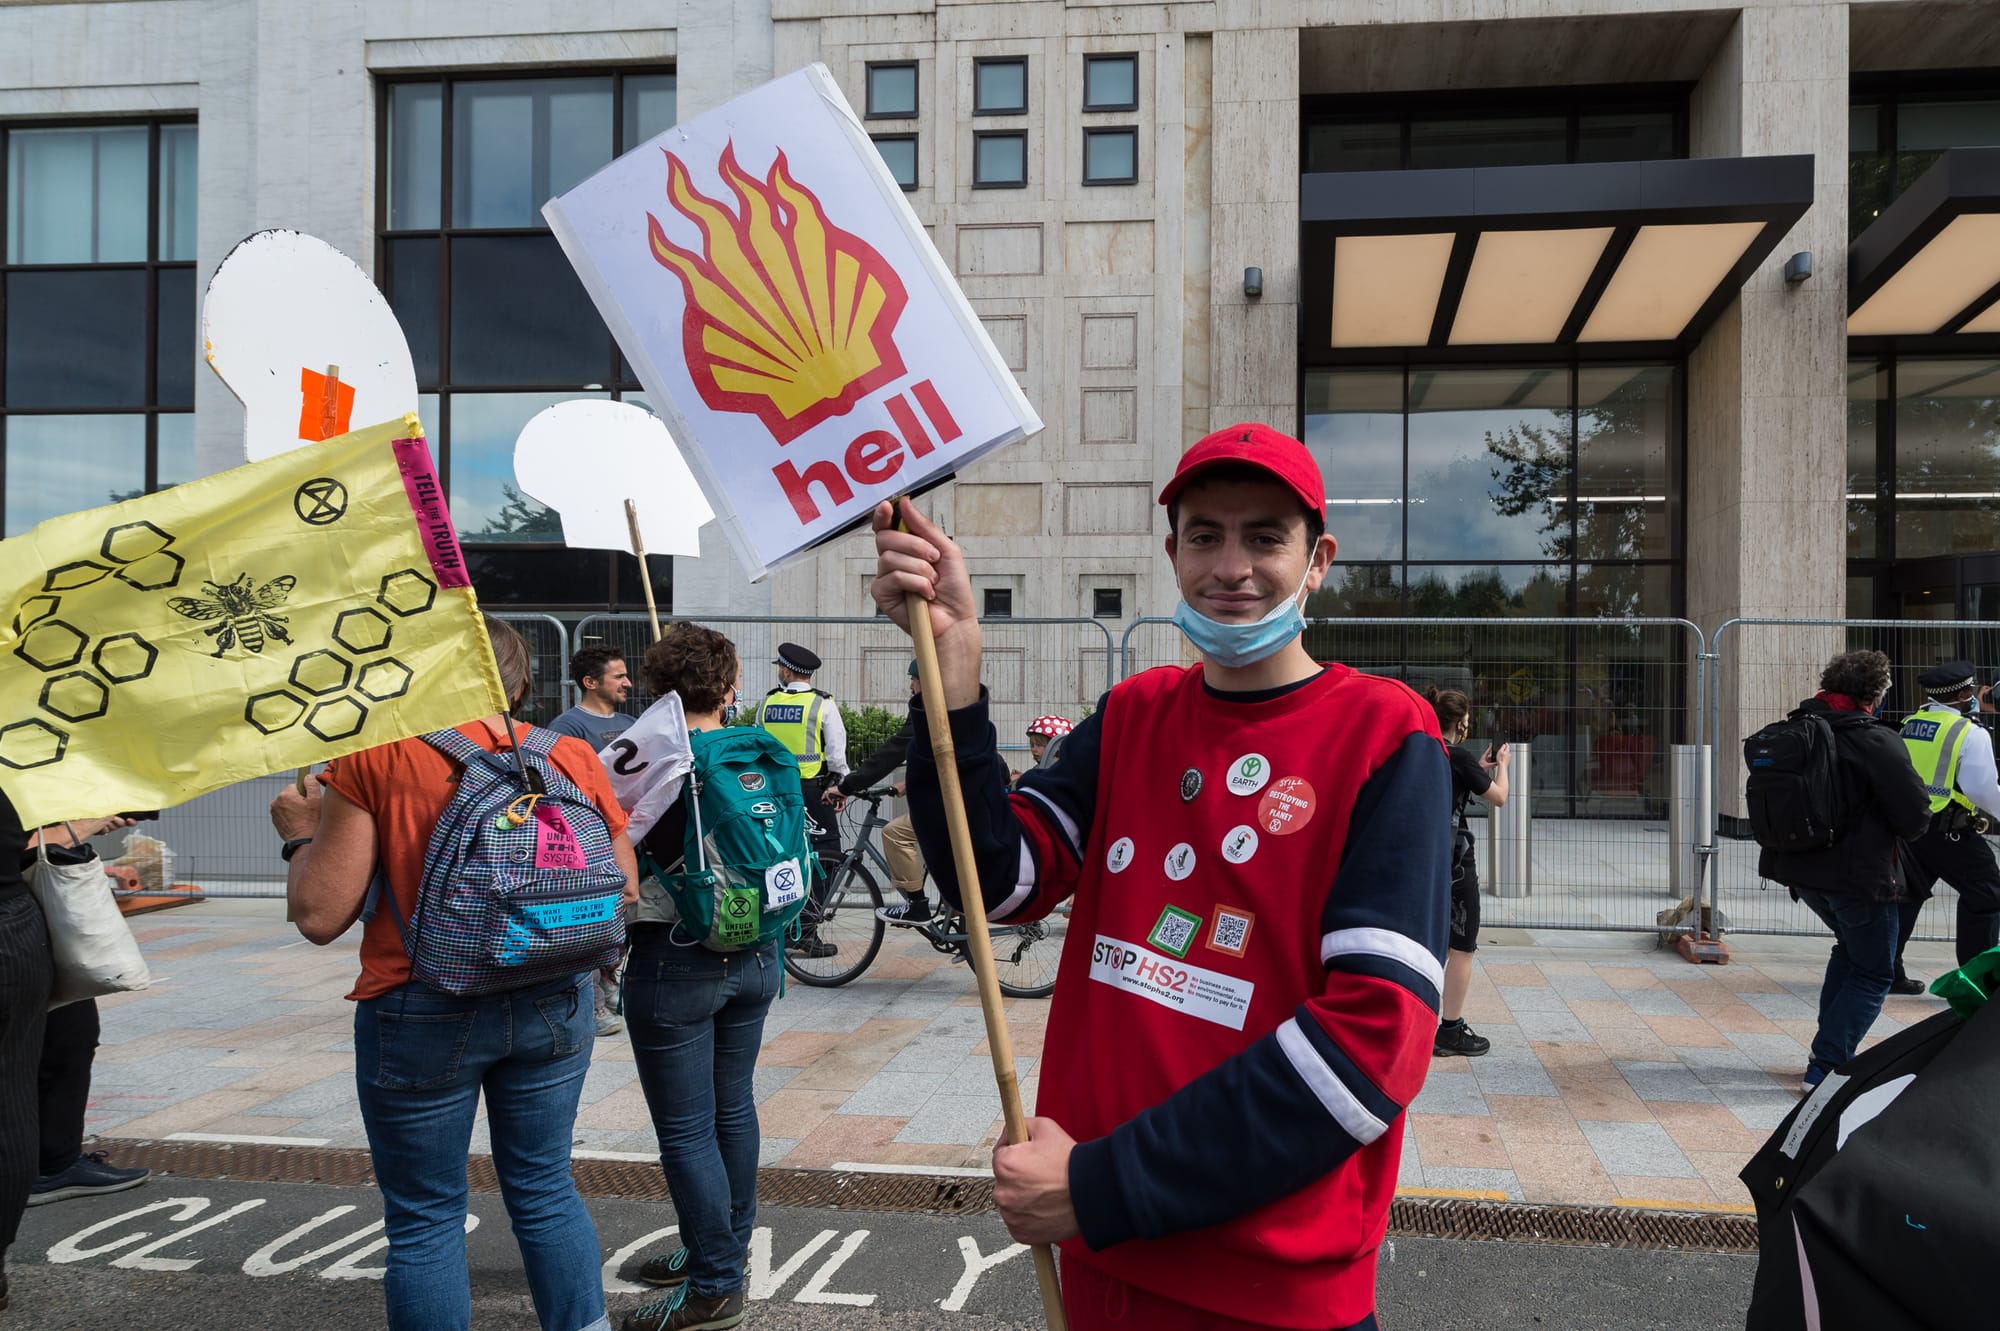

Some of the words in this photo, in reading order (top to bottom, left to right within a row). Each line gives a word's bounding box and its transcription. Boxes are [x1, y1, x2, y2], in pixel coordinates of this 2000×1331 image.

[772, 379, 963, 526] hell
[413, 472, 439, 506] TELL
[429, 505, 441, 520] THE
[430, 521, 461, 569] TRUTH
[765, 707, 802, 720] POLICE
[1232, 776, 1259, 788] EARTH
[1269, 790, 1309, 809] DESTROYING
[1278, 801, 1291, 812] THE
[1269, 808, 1293, 822] PLANET
[778, 892, 798, 903] REBEL
[571, 905, 588, 913] FUCK
[590, 903, 605, 911] THIS
[543, 916, 562, 924] LIVE
[1093, 942, 1137, 970] STOP
[1136, 956, 1188, 993] HS2
[1122, 974, 1185, 1004] www.stophs2.org
[1197, 986, 1234, 1000] environmental
